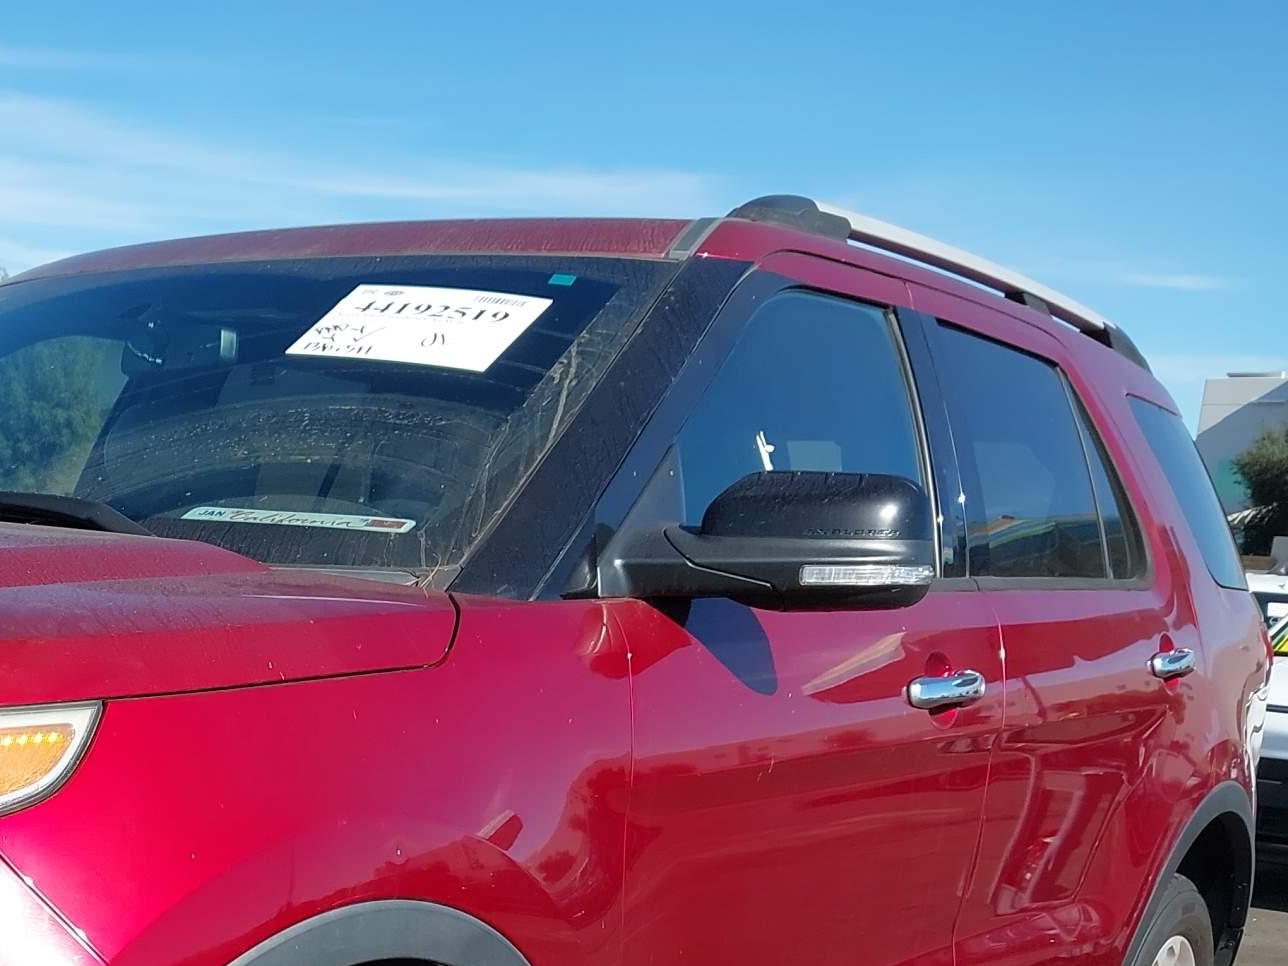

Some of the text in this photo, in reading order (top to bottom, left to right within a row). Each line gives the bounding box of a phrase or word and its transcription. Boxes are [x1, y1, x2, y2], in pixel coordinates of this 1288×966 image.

[355, 300, 509, 323] 44192519
[198, 510, 354, 528] JAN California
